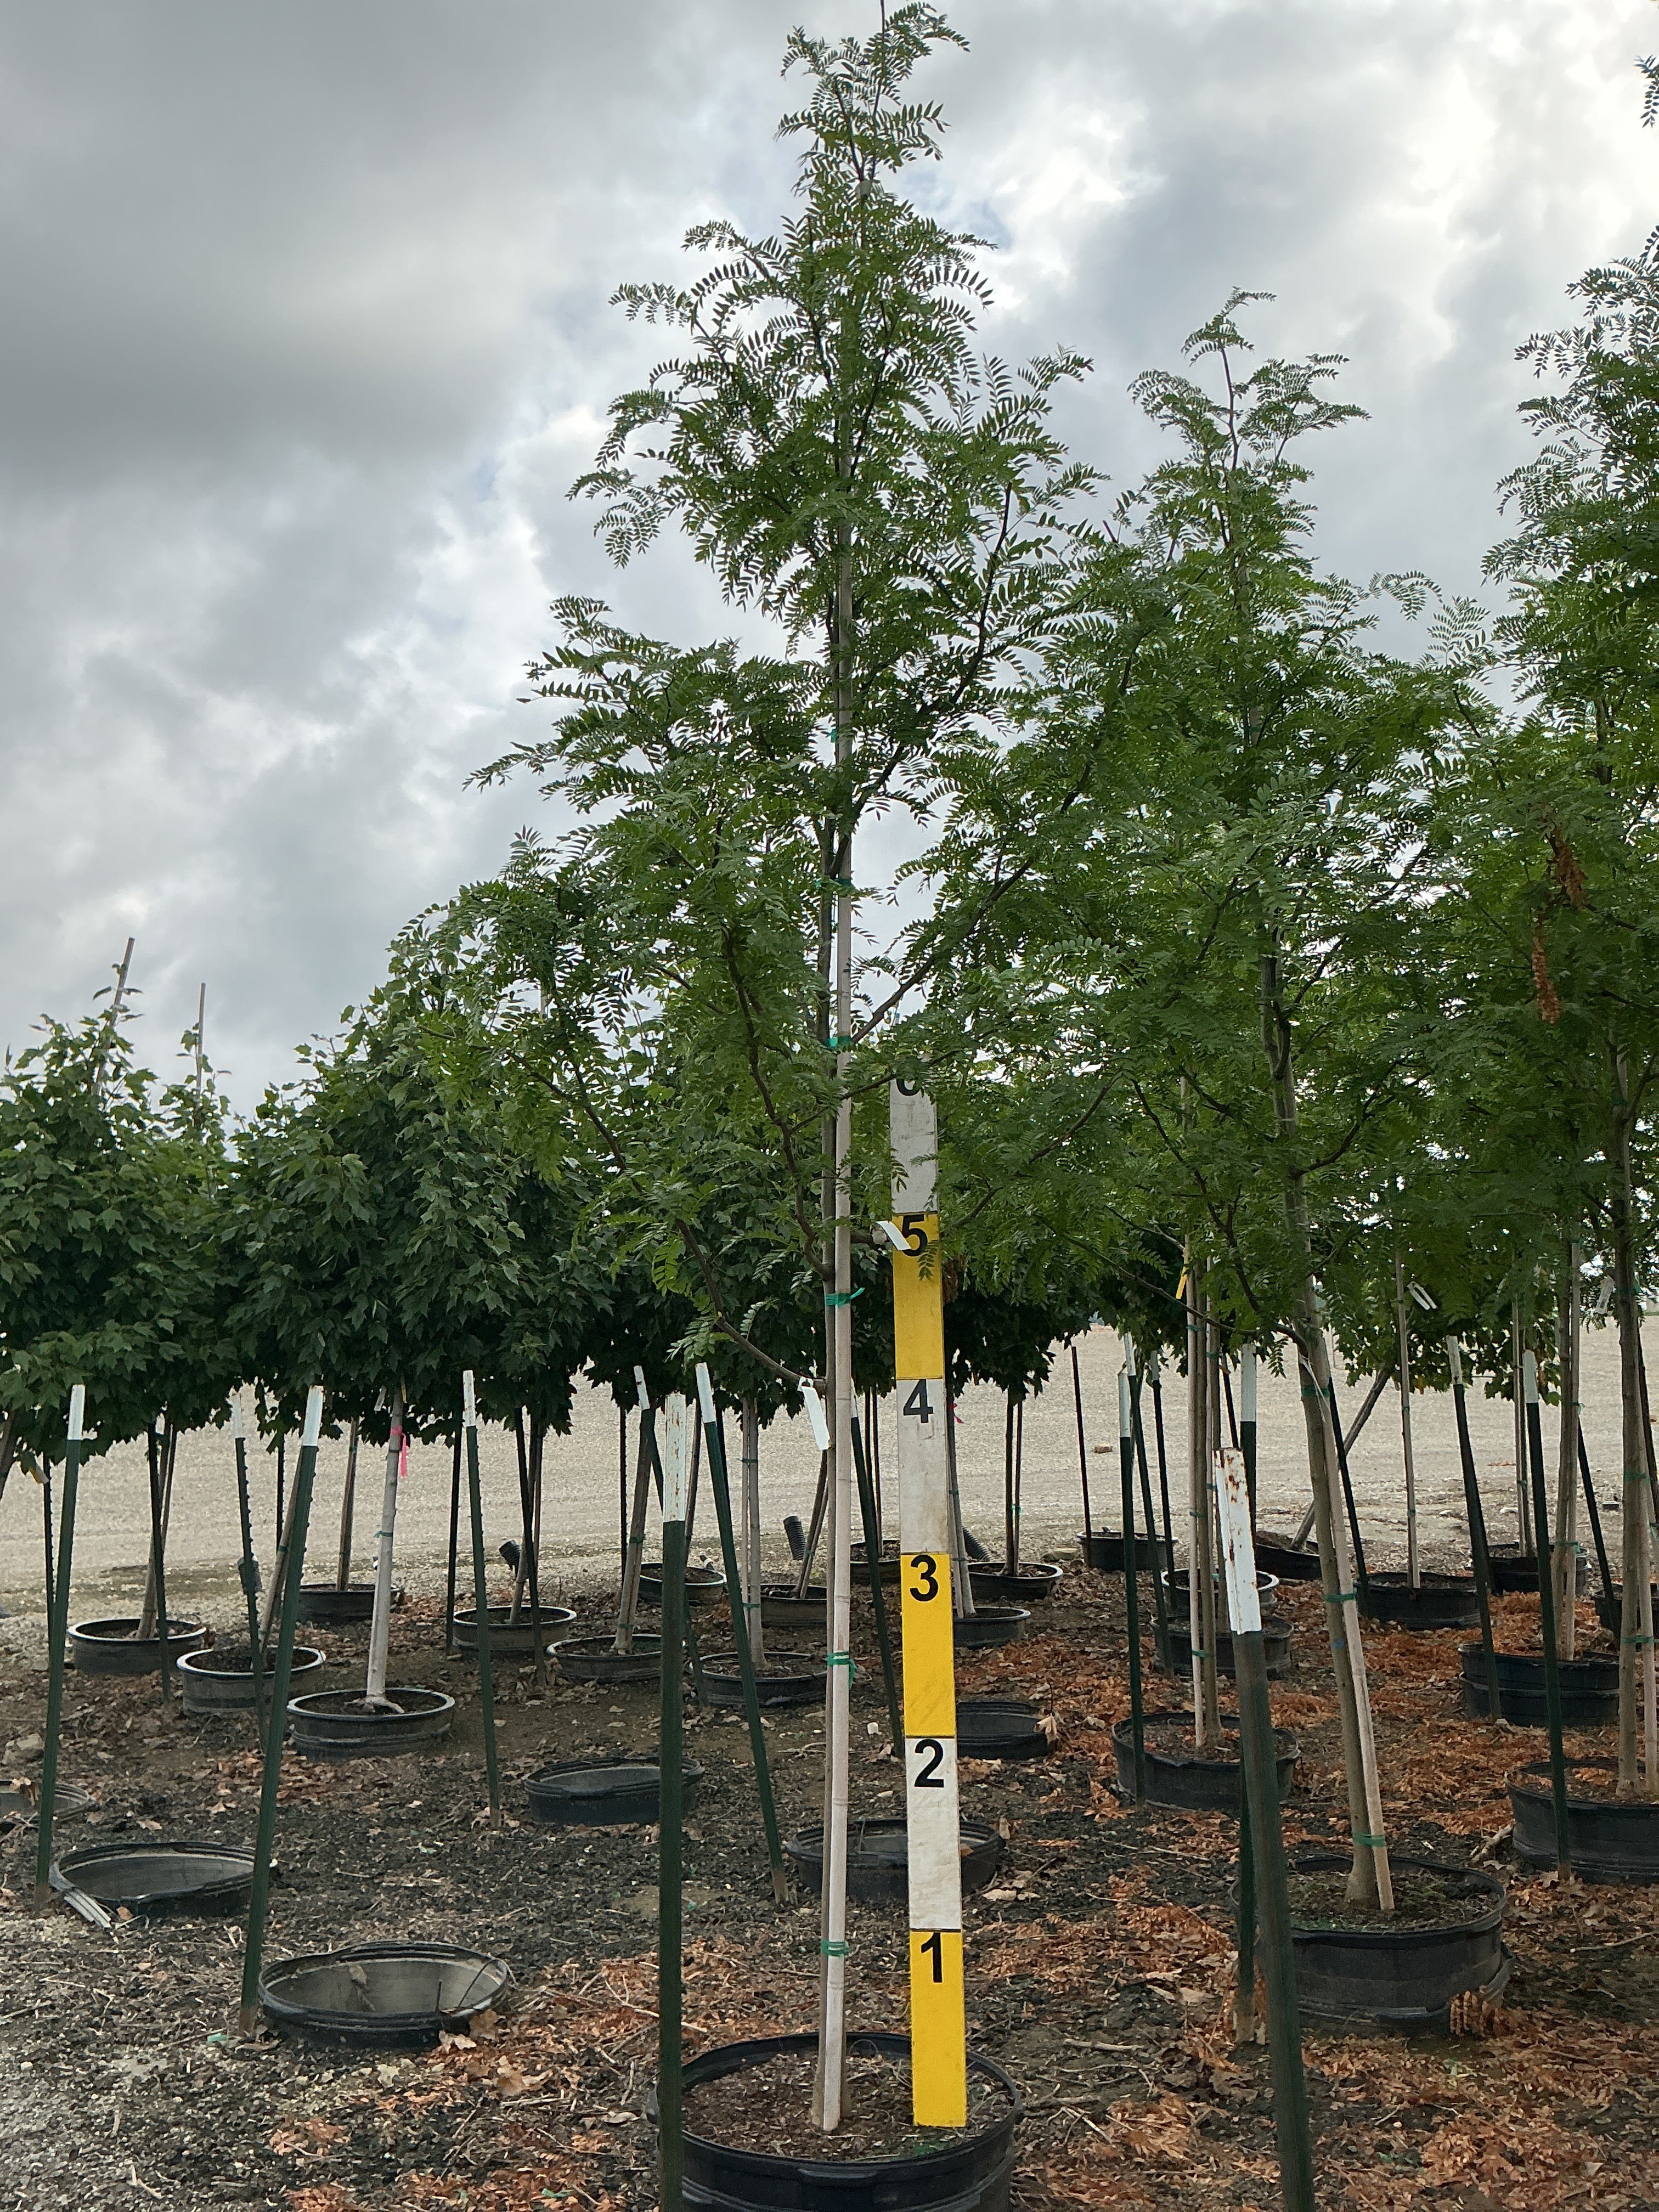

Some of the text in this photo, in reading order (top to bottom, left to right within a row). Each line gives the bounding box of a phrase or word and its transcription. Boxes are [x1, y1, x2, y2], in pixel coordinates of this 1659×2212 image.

[901, 1214, 928, 1256] 5
[903, 1379, 933, 1423] 4
[910, 1554, 939, 1601] 3
[914, 1739, 944, 1787] 2
[921, 1932, 943, 1983] 1
